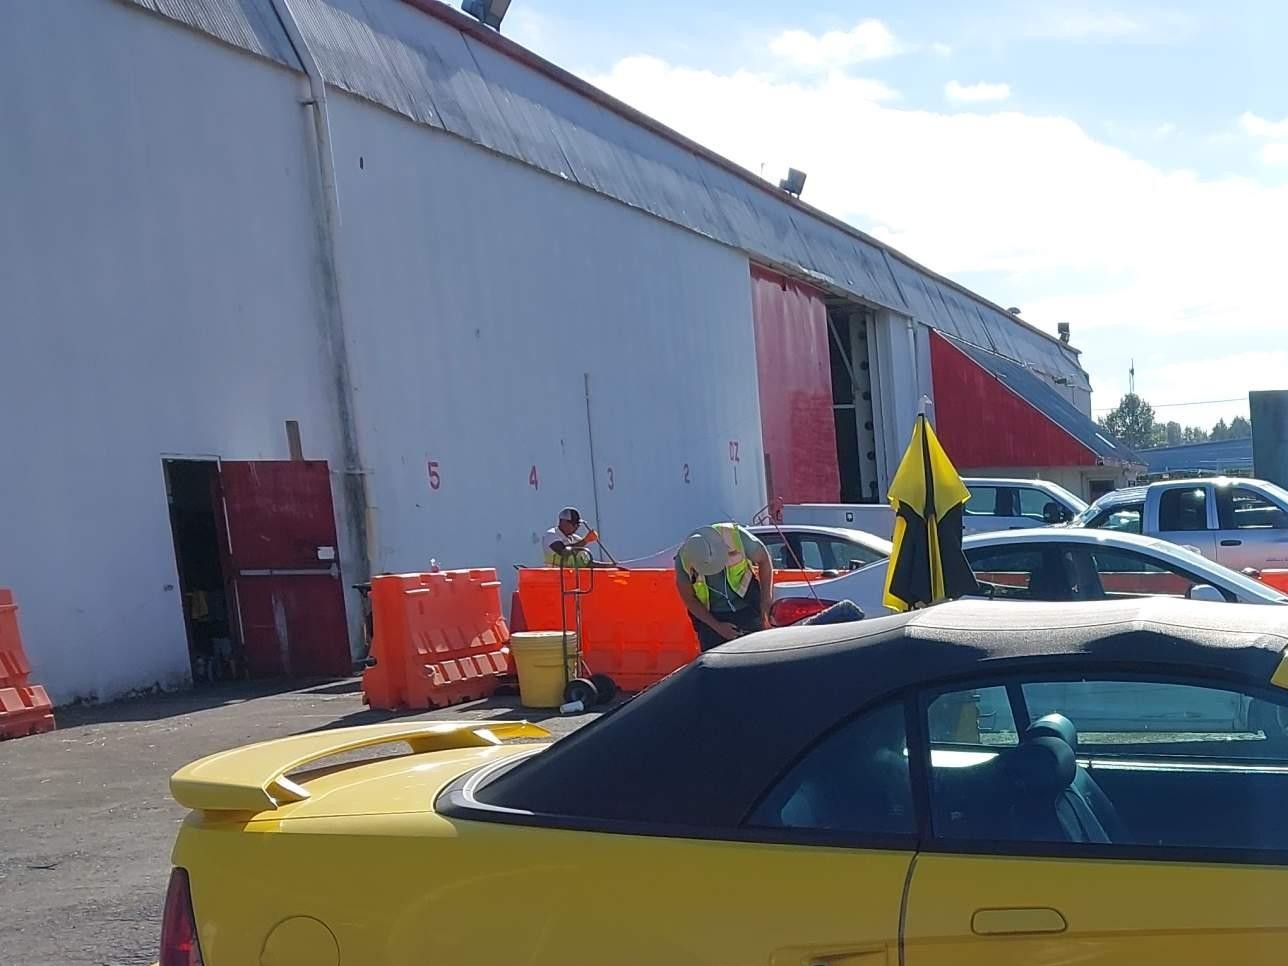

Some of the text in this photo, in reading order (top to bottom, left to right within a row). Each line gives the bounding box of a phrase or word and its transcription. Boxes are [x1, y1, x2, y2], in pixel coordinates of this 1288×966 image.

[427, 462, 441, 490] 5
[528, 465, 539, 491] 4
[607, 467, 615, 491] 3
[684, 463, 691, 484] 2
